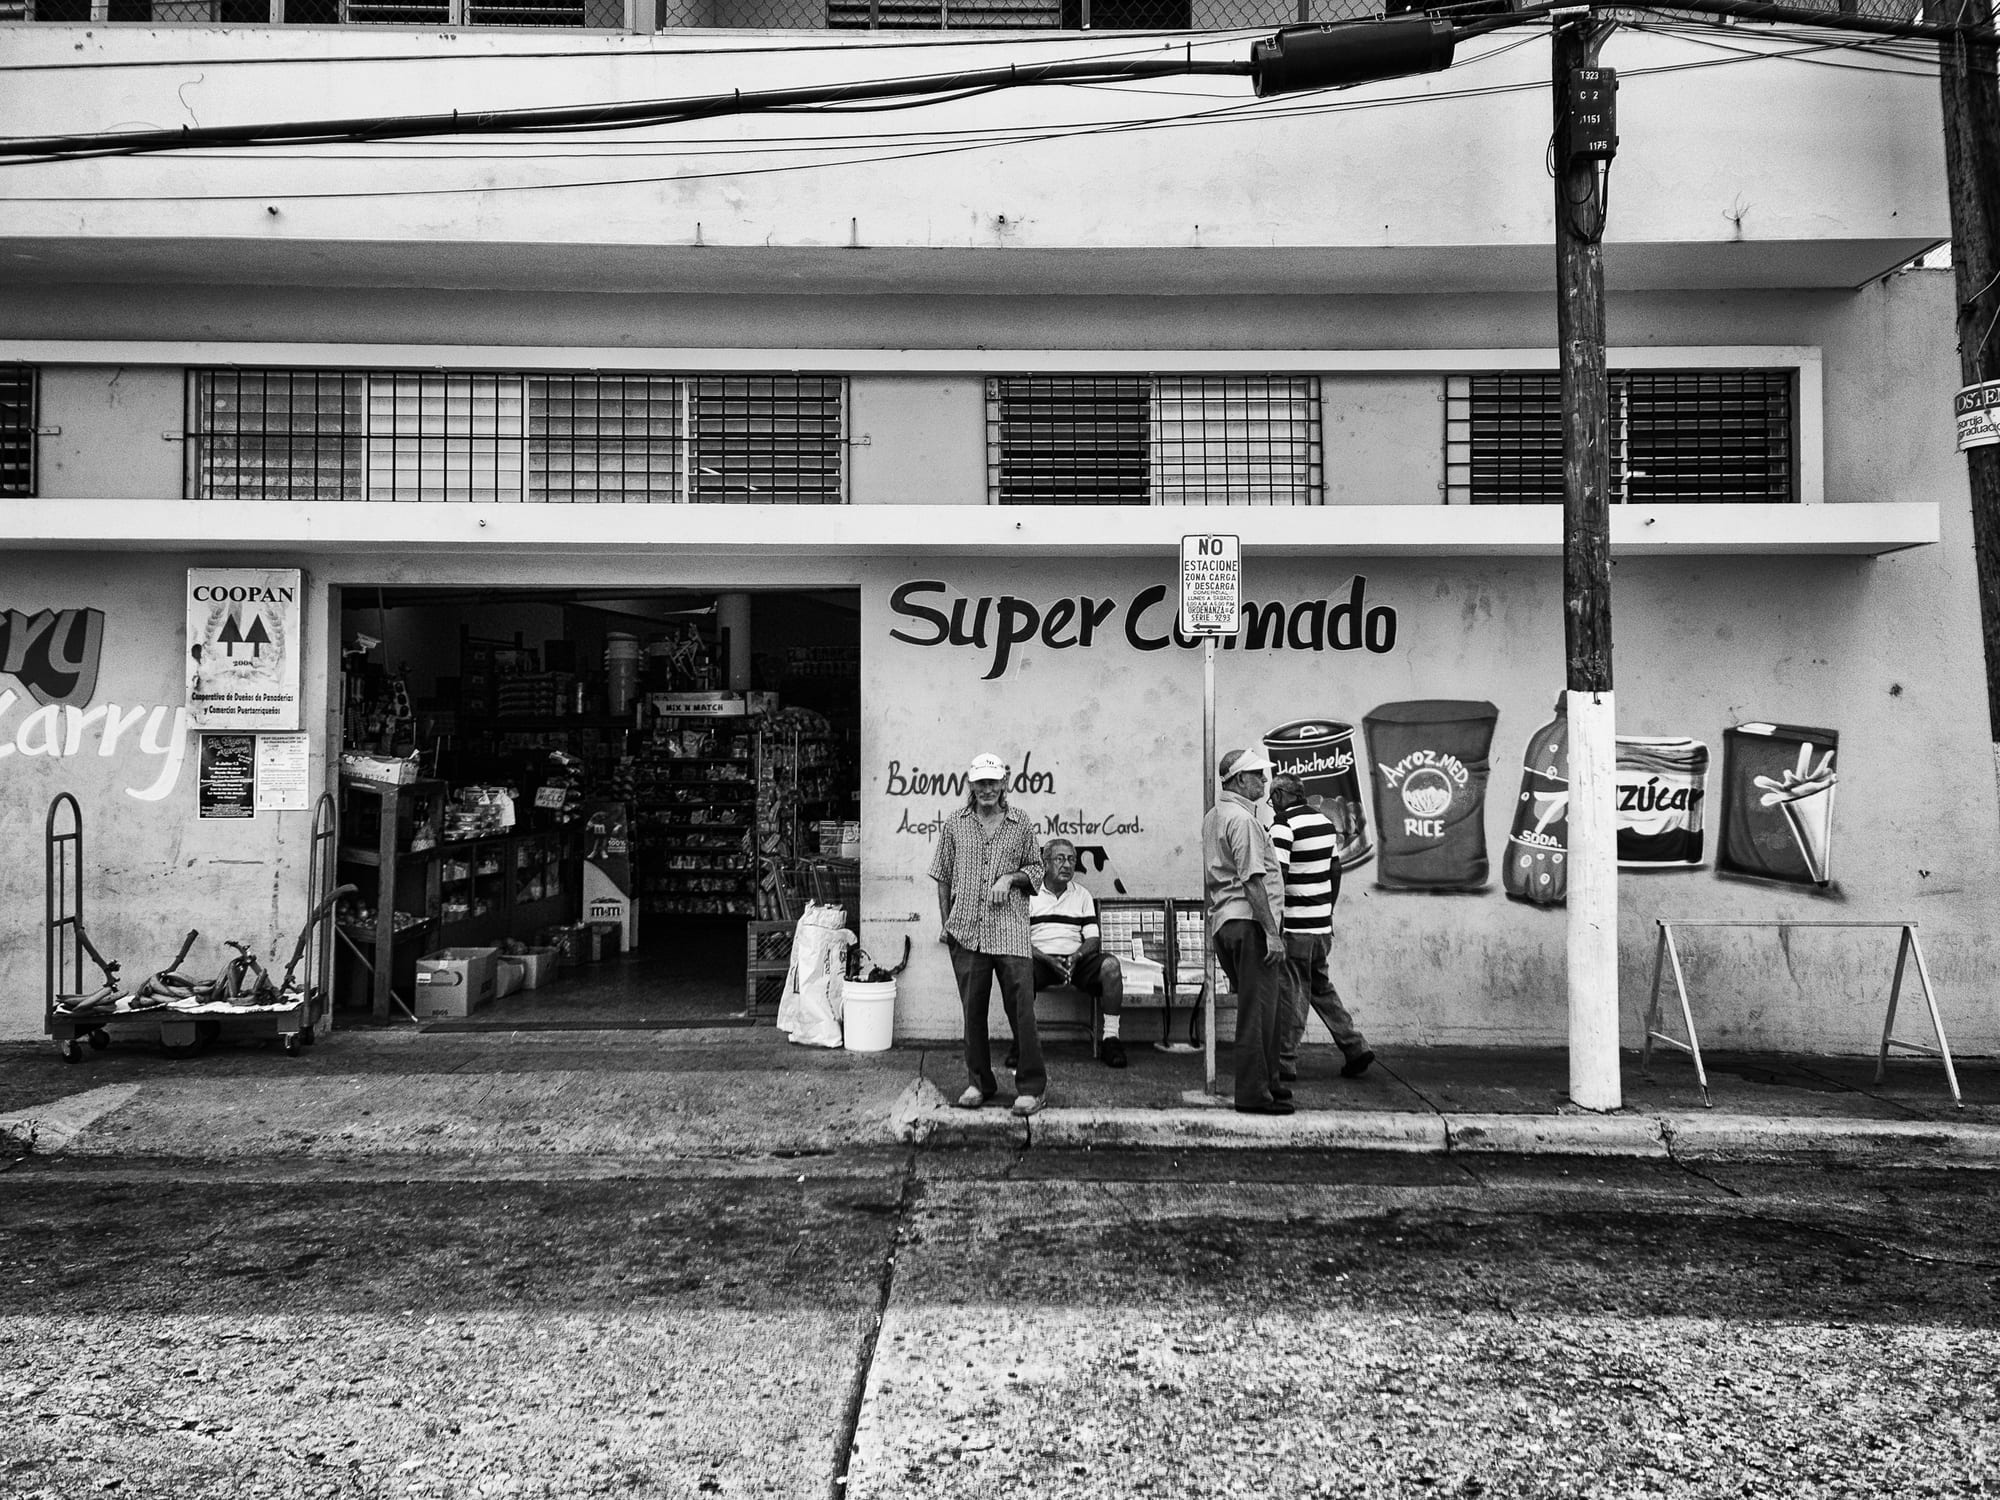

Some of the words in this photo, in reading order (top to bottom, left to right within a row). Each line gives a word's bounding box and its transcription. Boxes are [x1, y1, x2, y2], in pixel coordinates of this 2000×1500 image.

[1580, 71, 1599, 80] T323
[1580, 91, 1587, 100] C
[1593, 91, 1599, 100] 2
[1589, 140, 1608, 150] 1175
[1198, 538, 1223, 556] NO
[1184, 560, 1238, 572] ESTACIONE
[1185, 573, 1206, 581] ZONA
[1209, 573, 1236, 581] CARGA
[1186, 582, 1191, 590] Y
[1195, 582, 1235, 590] DESCARGA
[193, 585, 295, 603] COOPAN
[1187, 606, 1225, 614] ORDENANZA
[889, 580, 1117, 680] Super
[1125, 574, 1397, 653] Cmado
[191, 692, 225, 702] Cooperativa
[226, 693, 233, 701] de
[234, 692, 254, 701] Dueños
[255, 693, 262, 701] de
[209, 705, 236, 714] Comercios
[237, 705, 281, 716] Puertorriqueños
[693, 703, 723, 711] MATCH
[886, 750, 1056, 797] Bienvidos
[896, 807, 944, 843] Acept
[1404, 818, 1445, 838] RICE
